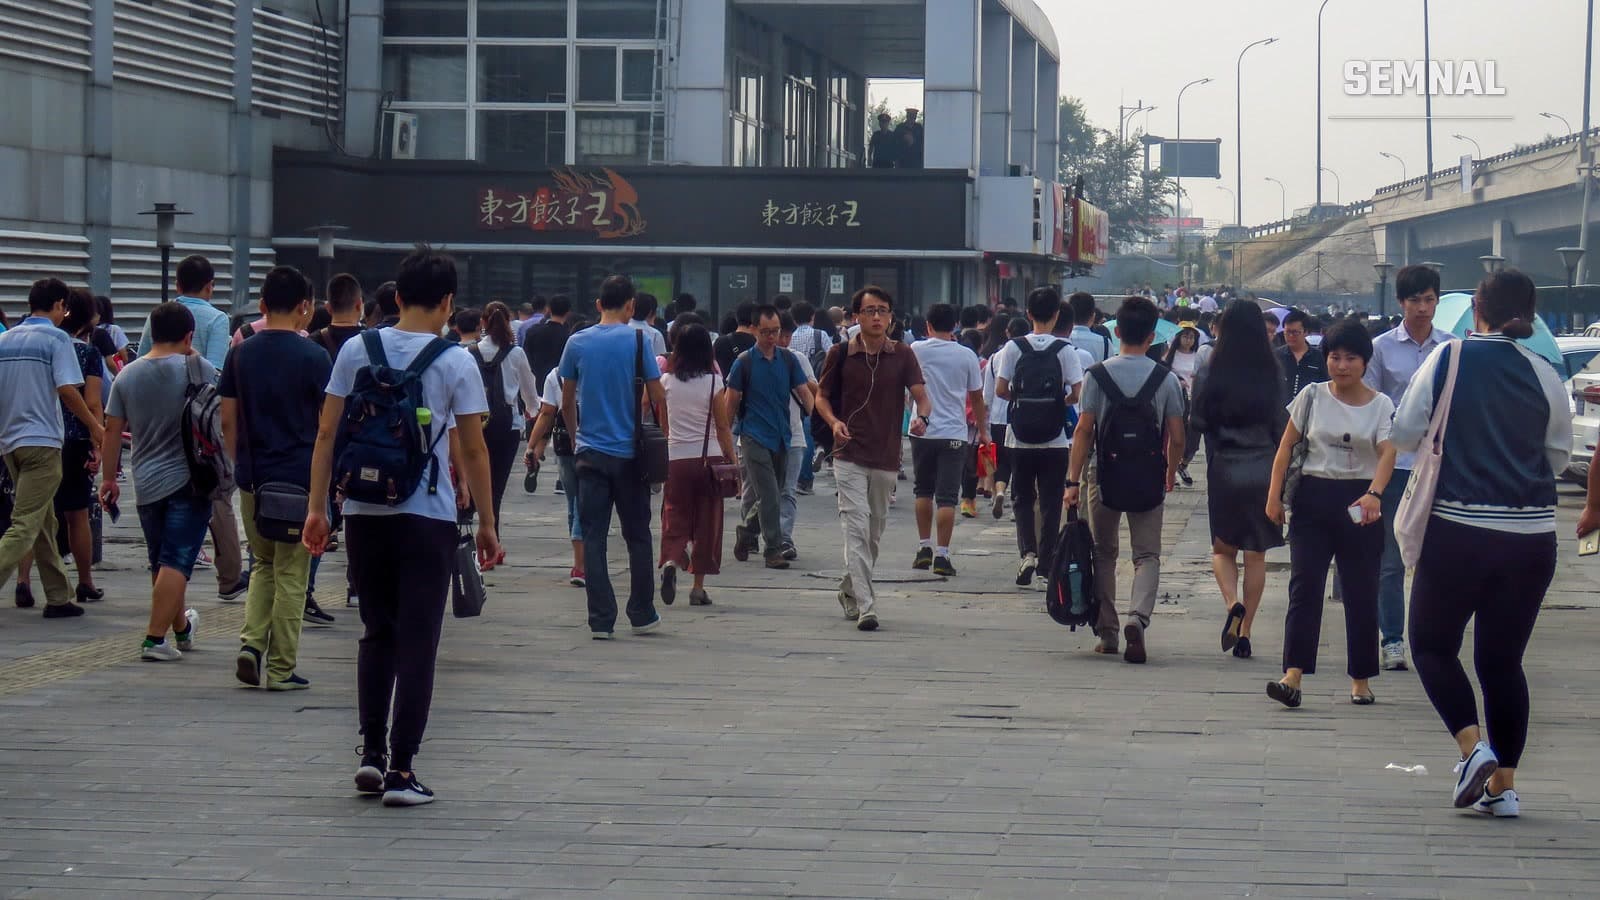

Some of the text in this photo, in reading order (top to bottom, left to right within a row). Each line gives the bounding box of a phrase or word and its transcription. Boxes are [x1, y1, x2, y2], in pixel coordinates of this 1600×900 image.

[480, 189, 611, 226] 東方餃子王
[761, 199, 861, 227] 東方餃子王
